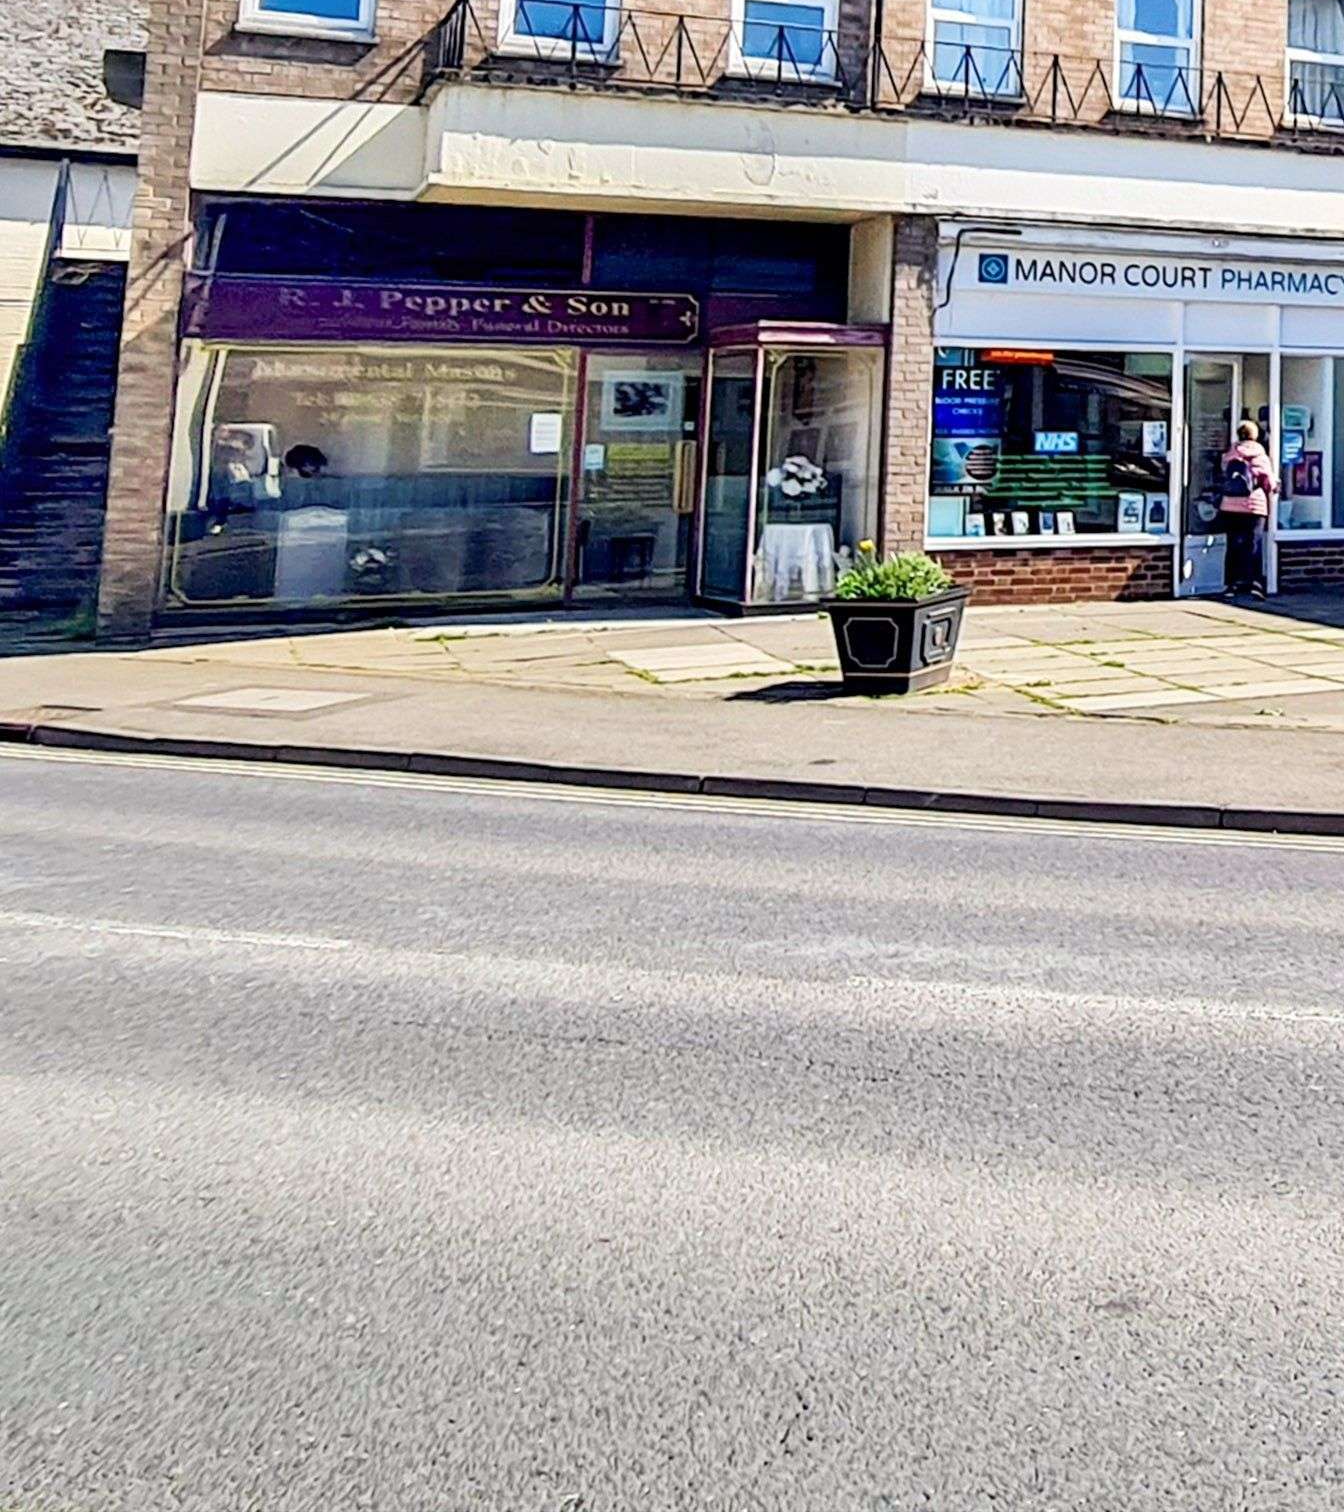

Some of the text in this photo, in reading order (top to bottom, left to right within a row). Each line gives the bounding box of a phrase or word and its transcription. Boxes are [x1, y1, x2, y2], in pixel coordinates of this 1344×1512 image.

[1015, 258, 1116, 285] MANOR
[1124, 264, 1213, 289] COURT
[379, 290, 512, 316] Pepper
[521, 295, 553, 315] &
[567, 298, 631, 317] Son
[942, 369, 996, 390] FREE
[1034, 431, 1078, 453] NHS
